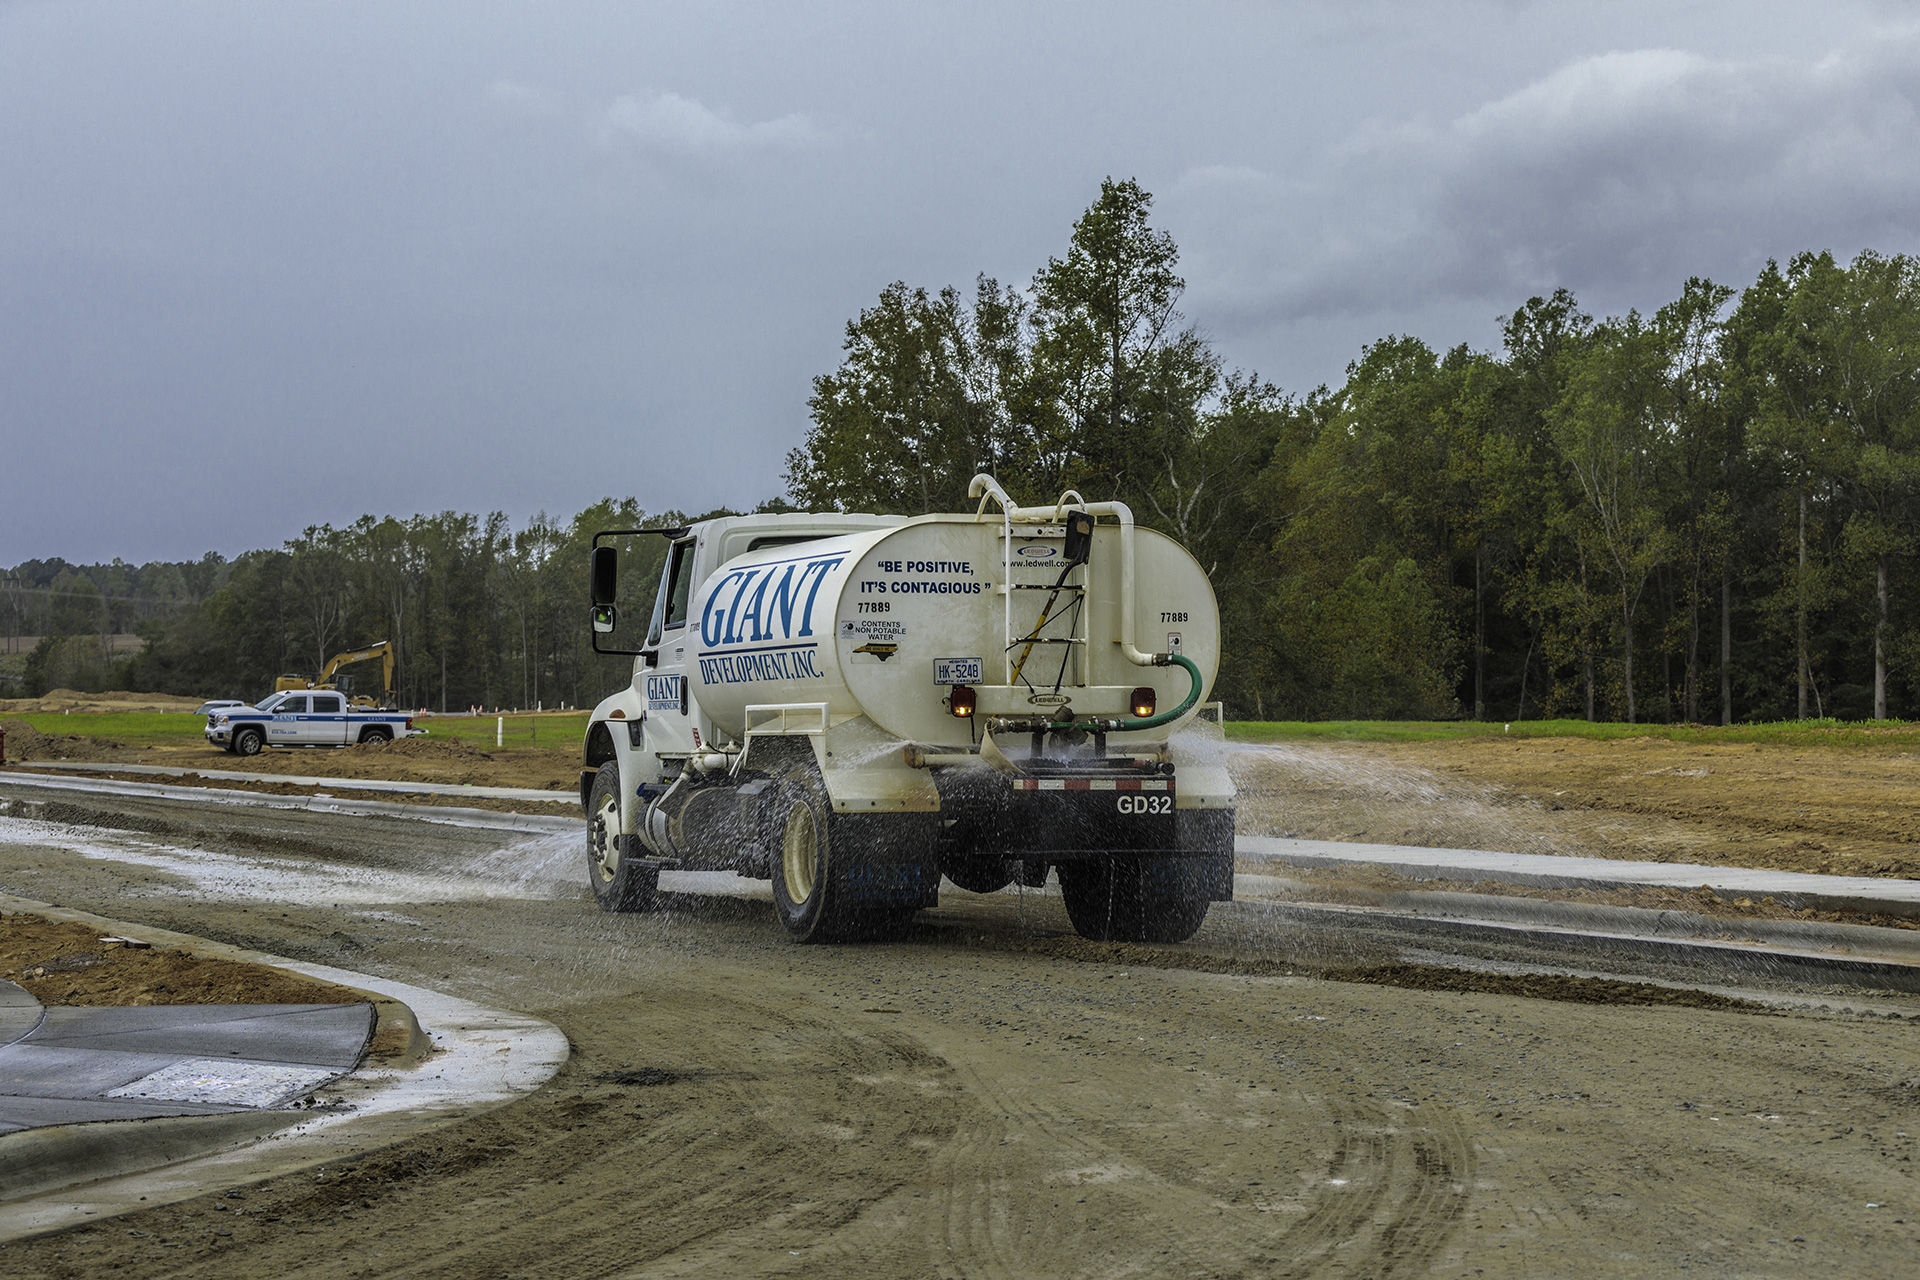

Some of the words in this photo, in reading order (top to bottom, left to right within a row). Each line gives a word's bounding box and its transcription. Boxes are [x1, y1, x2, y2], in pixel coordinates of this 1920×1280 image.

[907, 561, 974, 575] POSITIVE,
[891, 581, 981, 594] CONTAGIOUS
[701, 557, 845, 647] GIANT
[858, 602, 891, 613] 77889
[1161, 612, 1188, 623] 77889
[938, 664, 979, 679] HK-5248
[647, 676, 680, 701] GIANT
[1117, 795, 1172, 814] GD32
